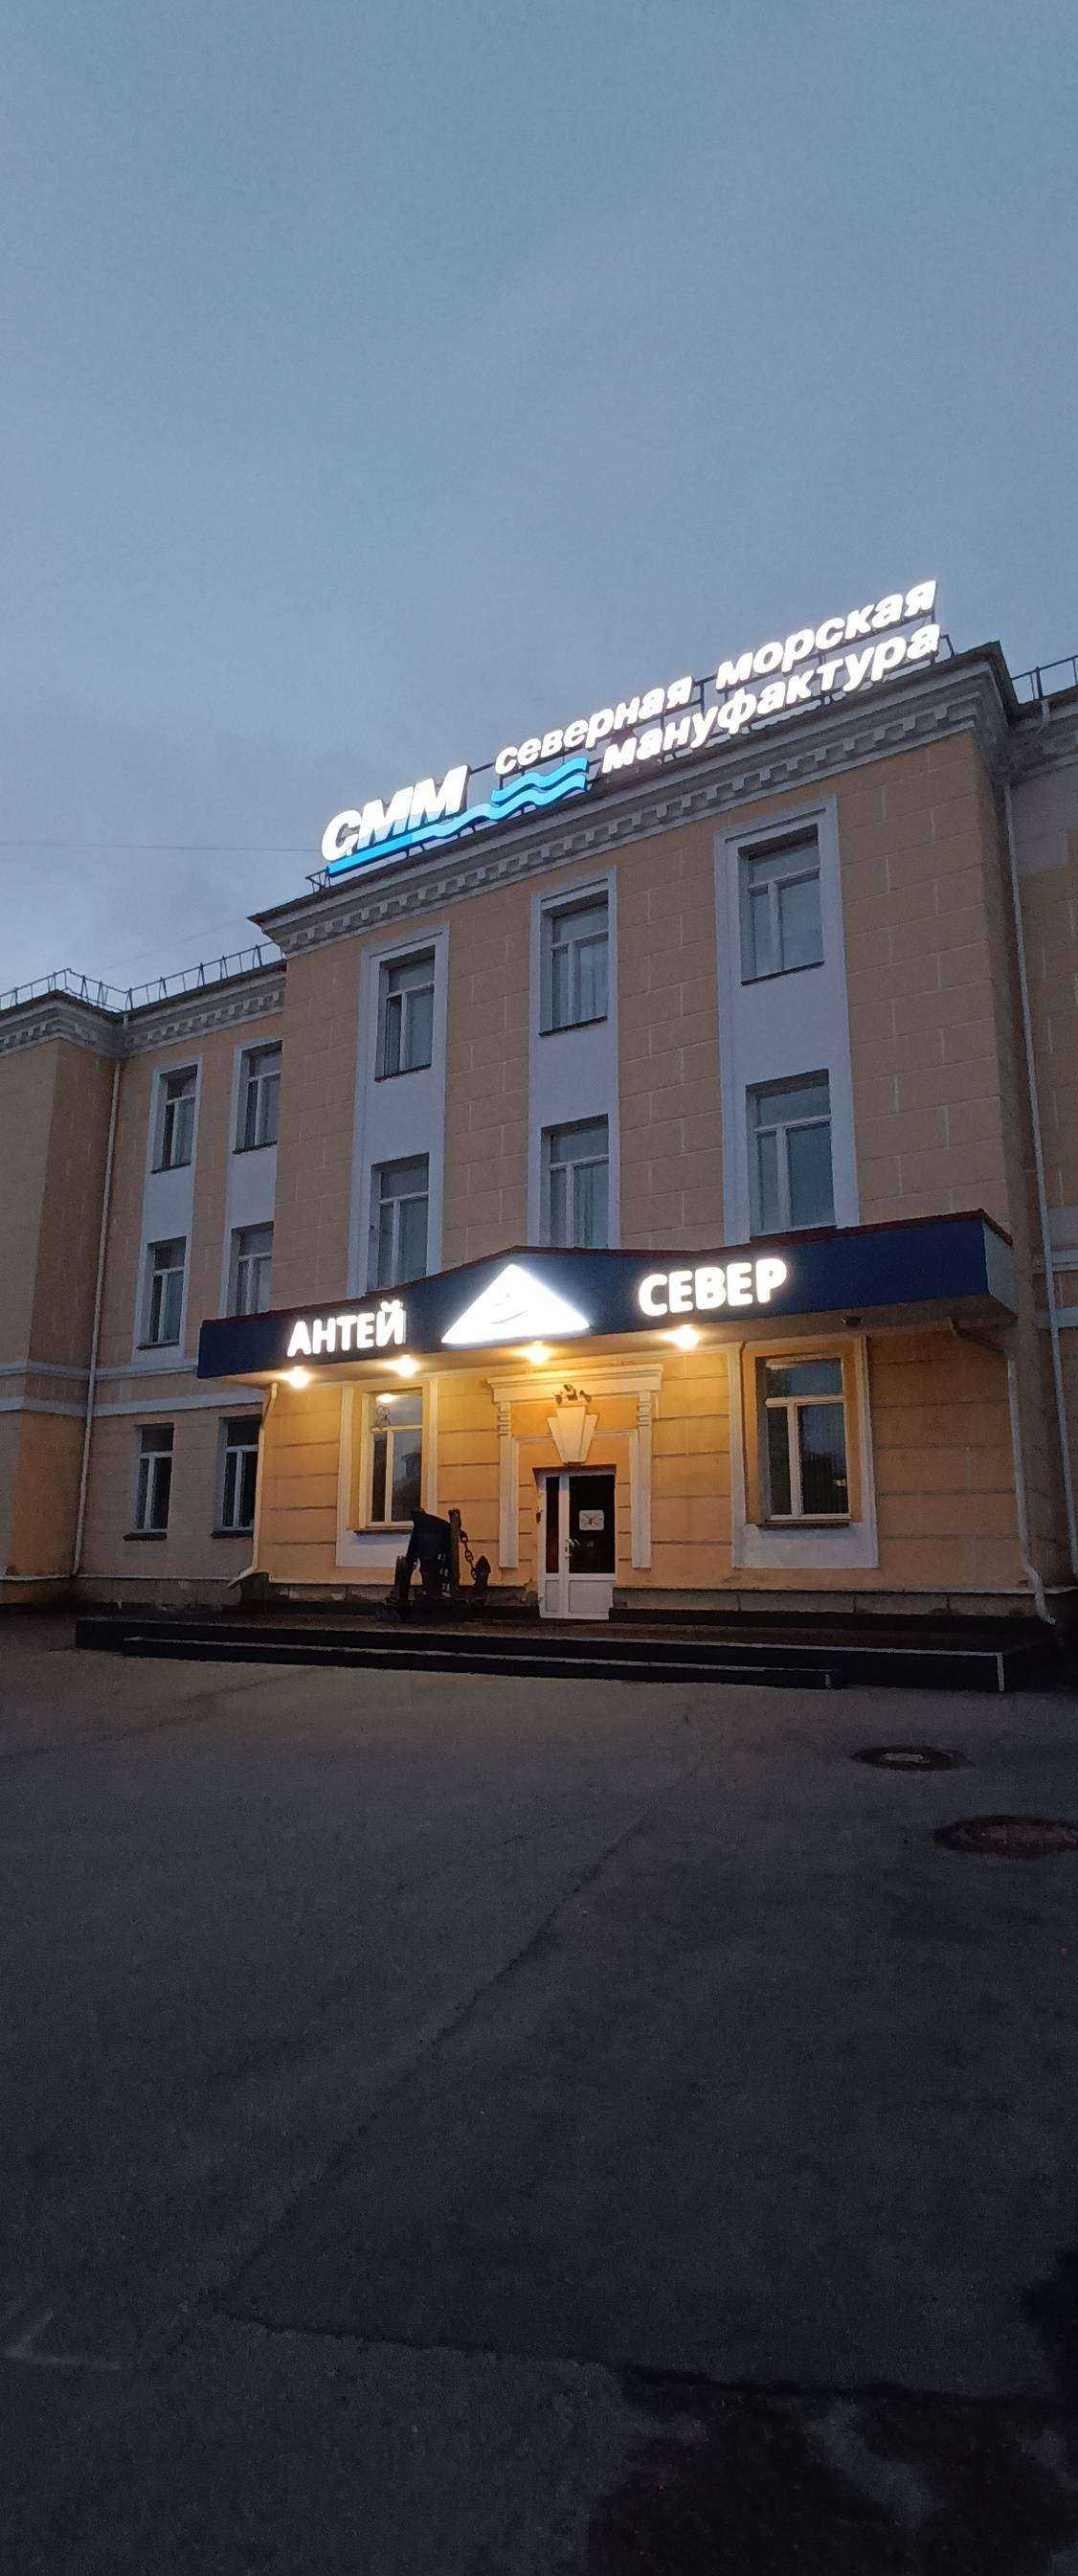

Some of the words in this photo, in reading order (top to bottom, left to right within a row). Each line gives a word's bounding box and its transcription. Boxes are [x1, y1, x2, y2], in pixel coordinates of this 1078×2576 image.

[494, 675, 694, 775] северная
[715, 579, 938, 691] морская
[600, 622, 941, 775] мануфактура
[321, 764, 470, 861] СММ
[286, 1299, 406, 1358] АНТЕЙ
[638, 1257, 788, 1318] СЕВЕР
